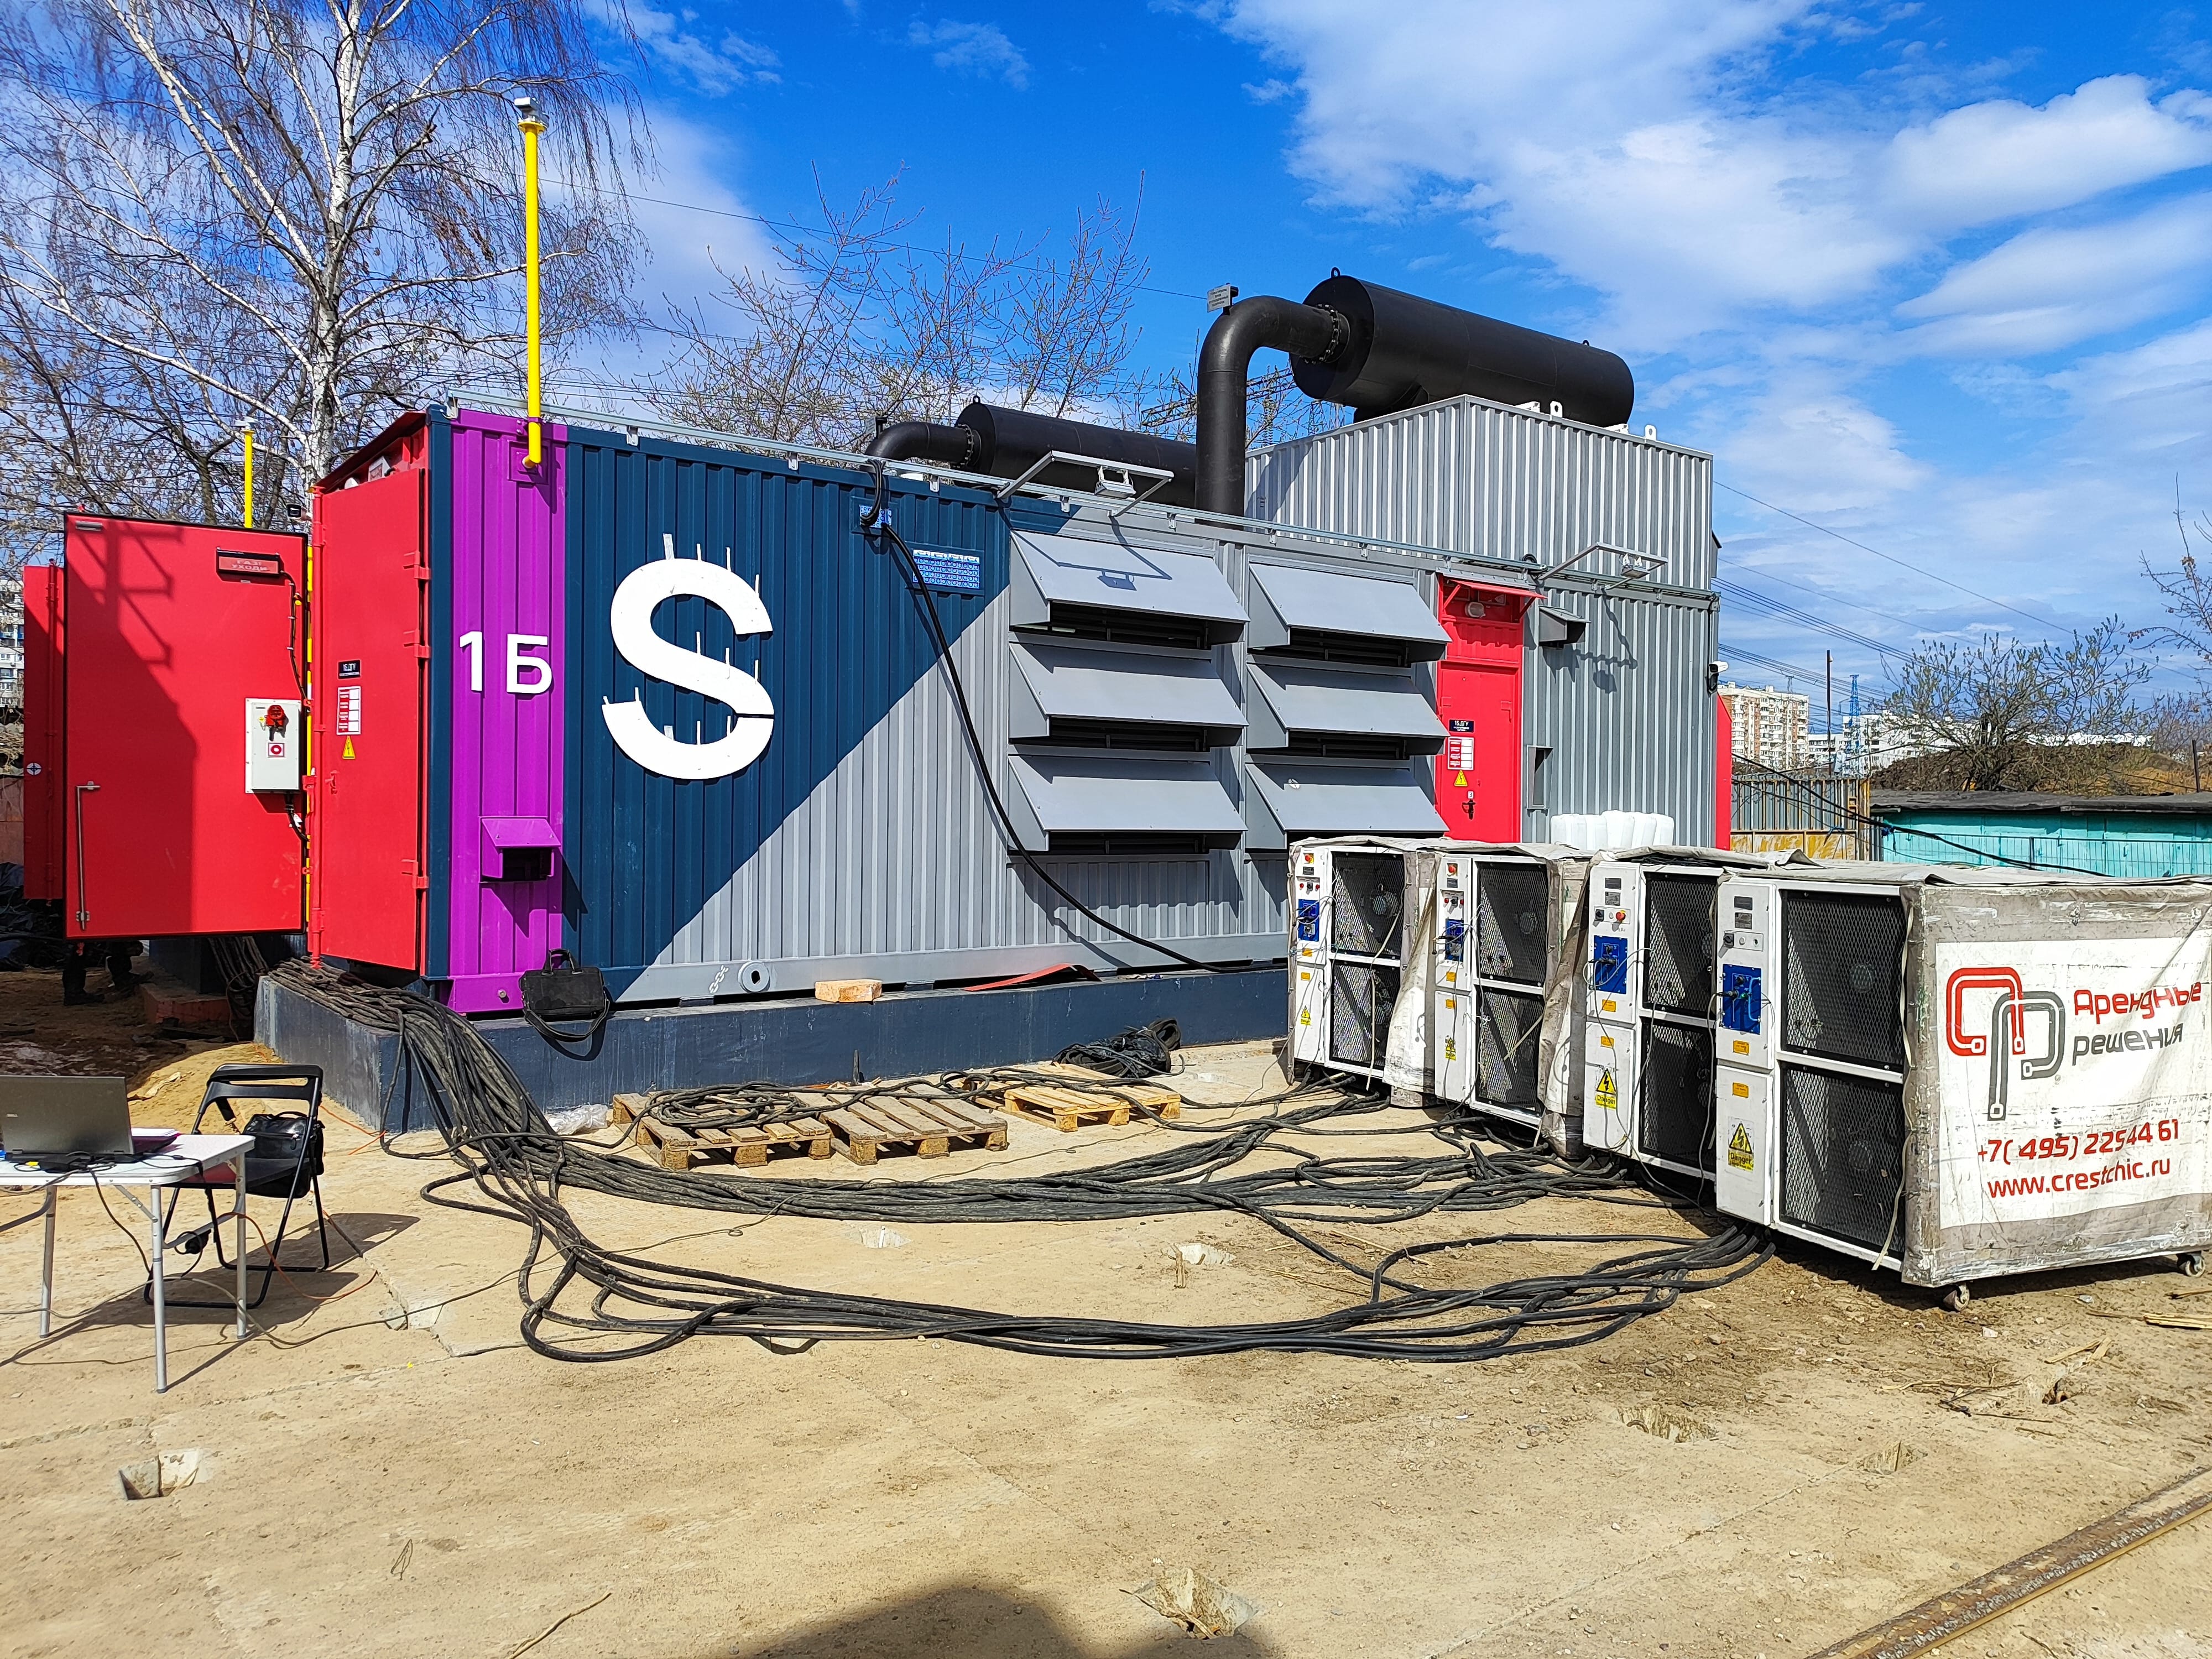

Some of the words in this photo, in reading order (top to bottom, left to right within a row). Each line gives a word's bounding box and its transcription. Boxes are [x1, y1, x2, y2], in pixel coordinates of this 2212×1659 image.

[2073, 981, 2203, 1025] Арендные
[2072, 1022, 2184, 1067] решения
[1730, 1152, 1751, 1165] Danger
[1987, 1157, 2171, 1198] www.crestchic.ru
